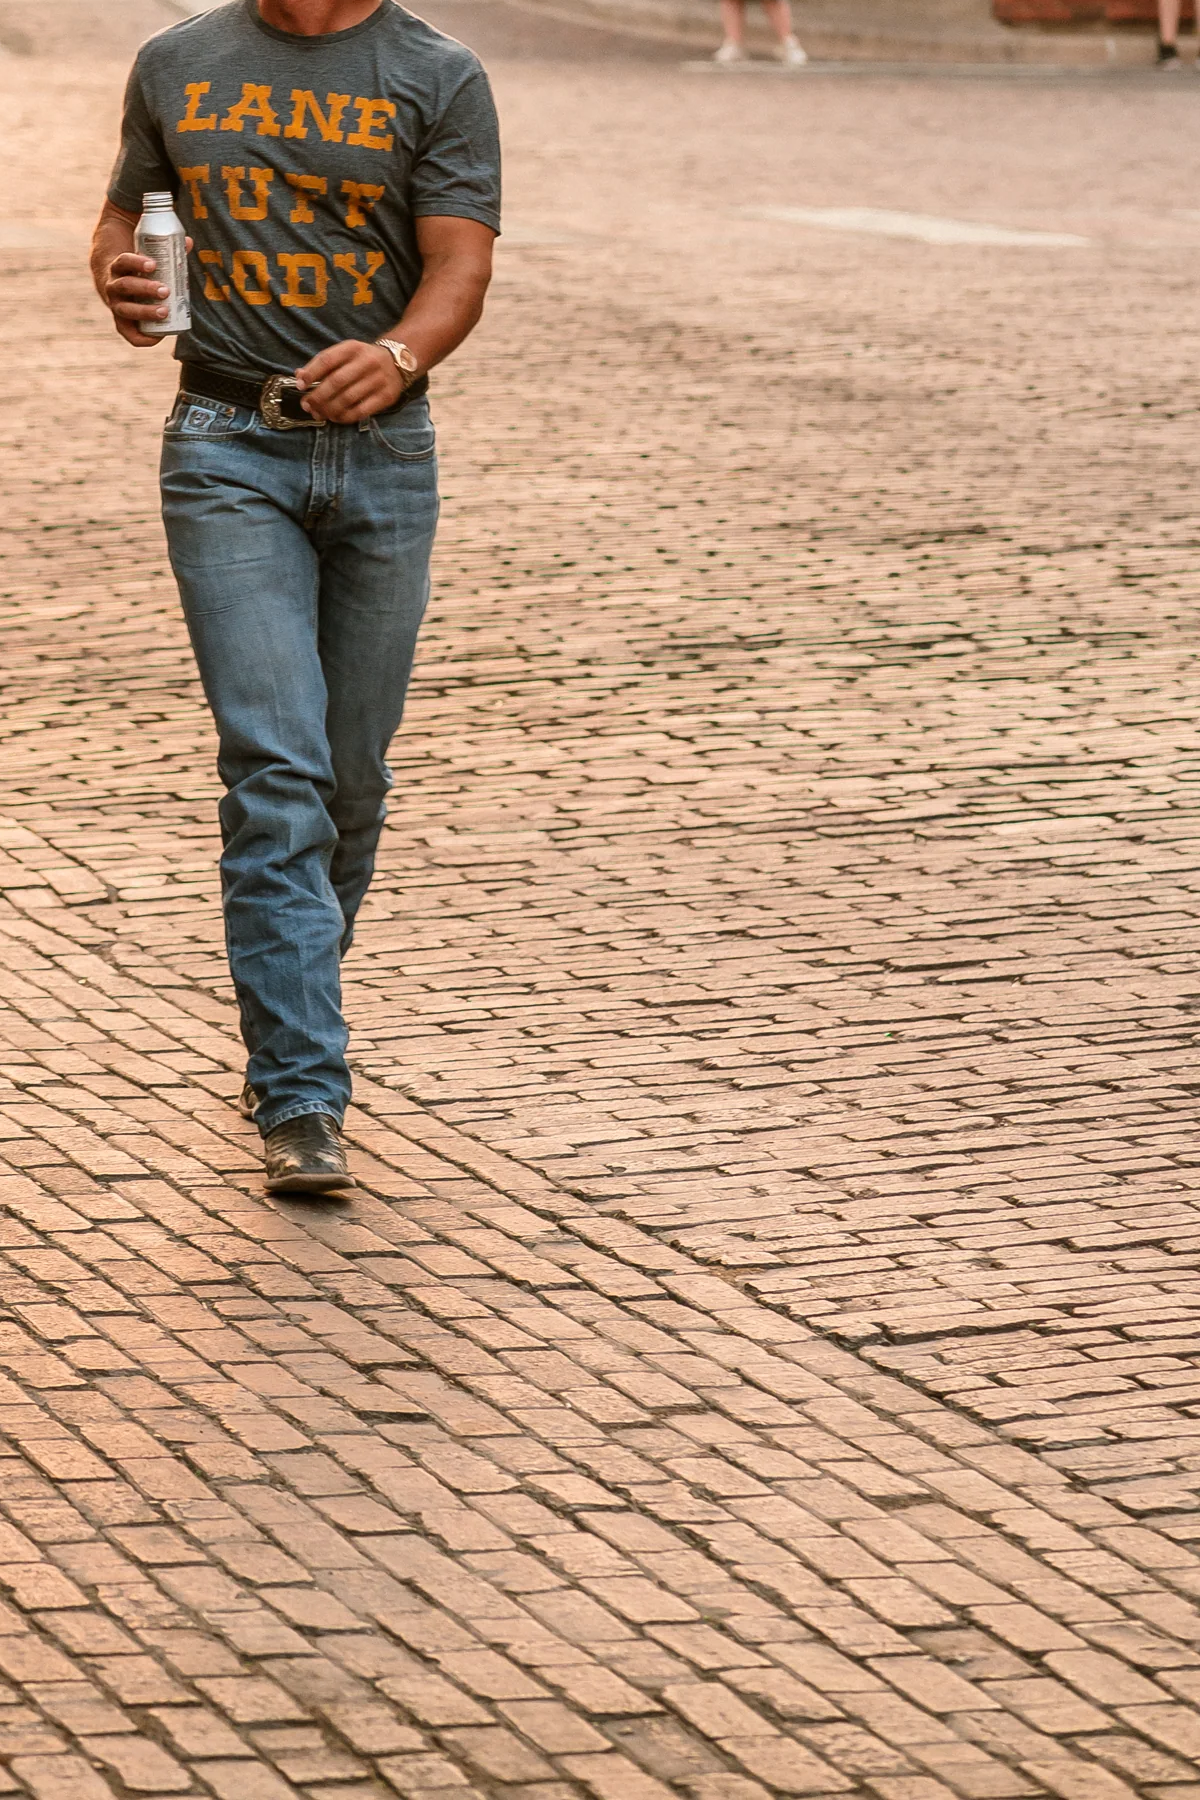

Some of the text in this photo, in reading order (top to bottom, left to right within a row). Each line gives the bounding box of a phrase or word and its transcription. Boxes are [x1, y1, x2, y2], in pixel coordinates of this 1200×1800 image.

[176, 82, 397, 152] LANE
[179, 164, 386, 229] TUFF
[198, 250, 386, 308] CODY
